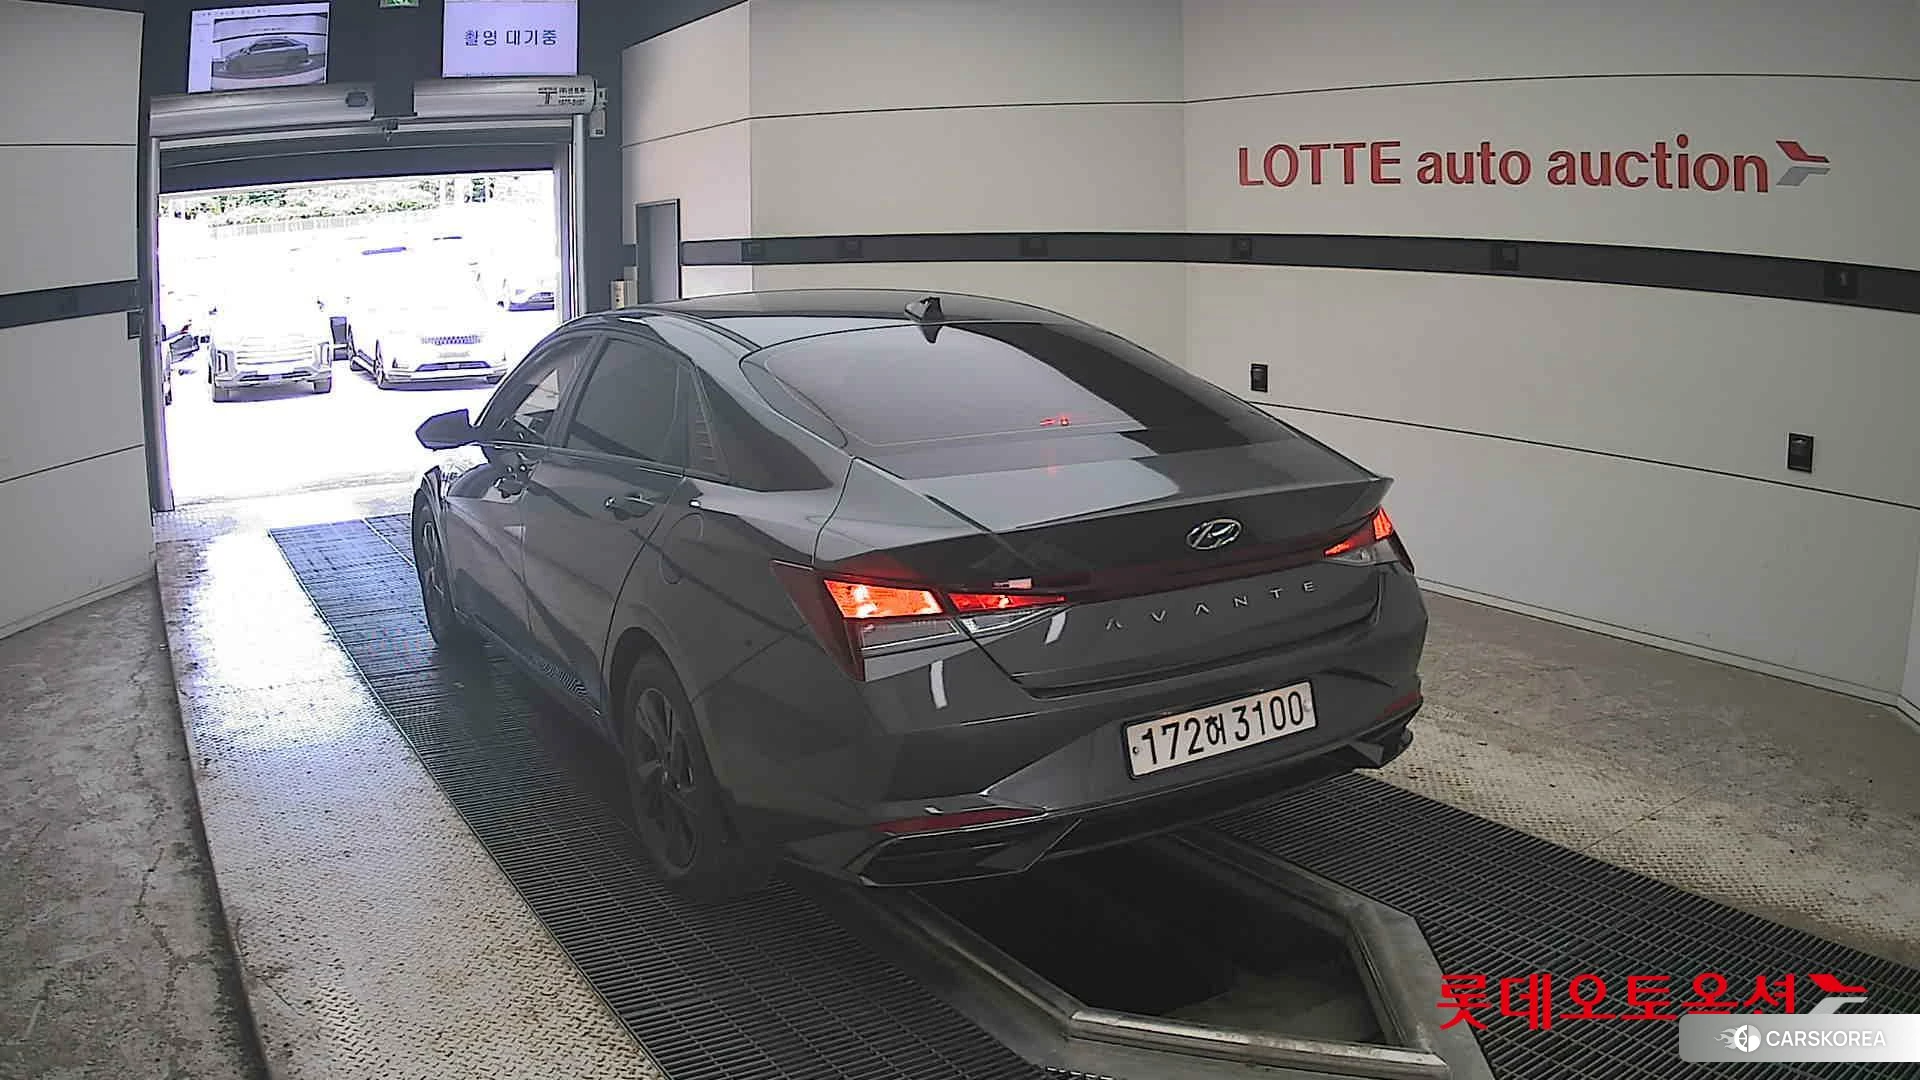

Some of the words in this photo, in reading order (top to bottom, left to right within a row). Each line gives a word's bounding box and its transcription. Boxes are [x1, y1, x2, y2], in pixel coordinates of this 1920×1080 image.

[506, 30, 557, 46] 대기중
[1239, 141, 1401, 187] LOTTE
[1417, 142, 1531, 185] auto
[1548, 134, 1768, 193] auction
[1105, 581, 1314, 631] AVANTE
